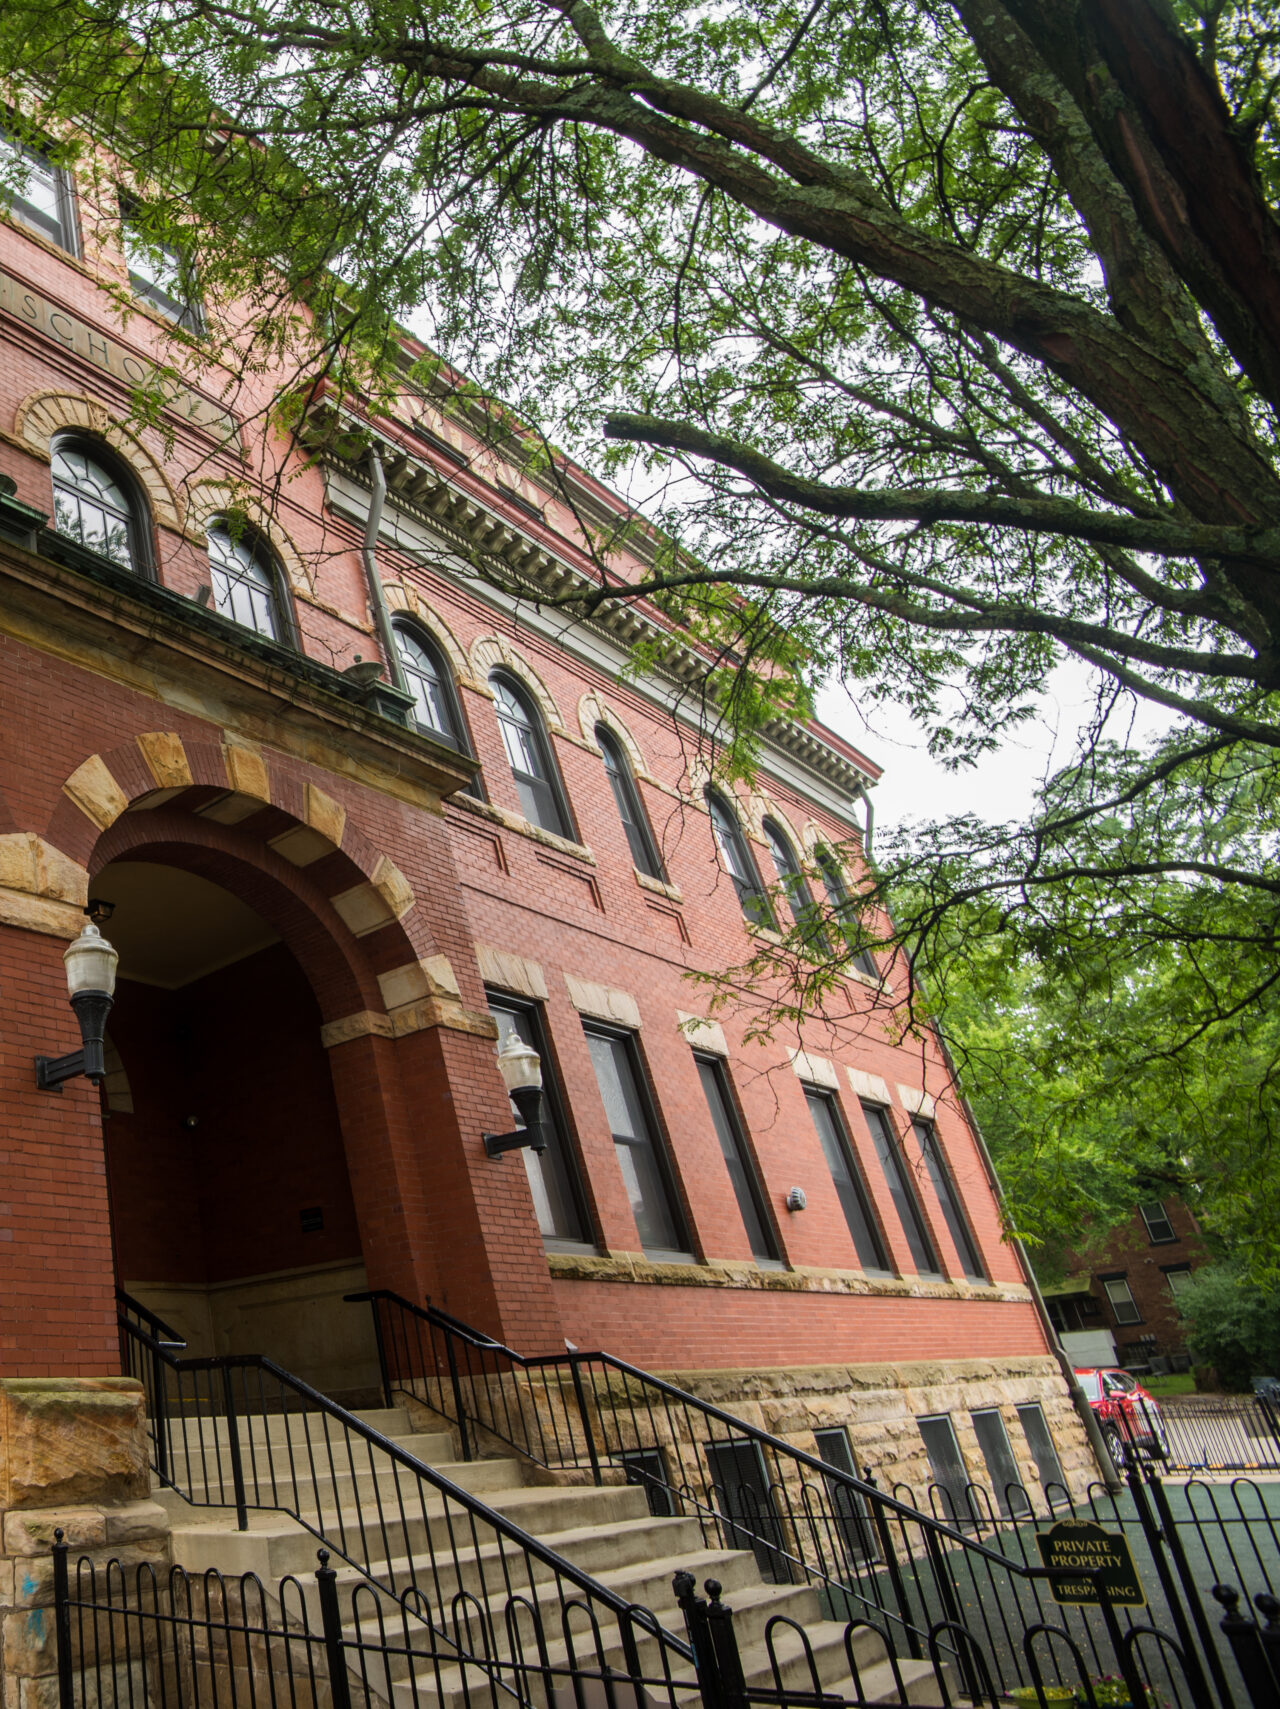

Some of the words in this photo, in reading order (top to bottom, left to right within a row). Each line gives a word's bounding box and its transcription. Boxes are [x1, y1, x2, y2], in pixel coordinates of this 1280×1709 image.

[21, 294, 203, 422] SCHOOL
[1053, 1540, 1111, 1552] PRIVATE
[1050, 1555, 1122, 1567] PROPERTY
[1056, 1584, 1135, 1597] TRESPASING
